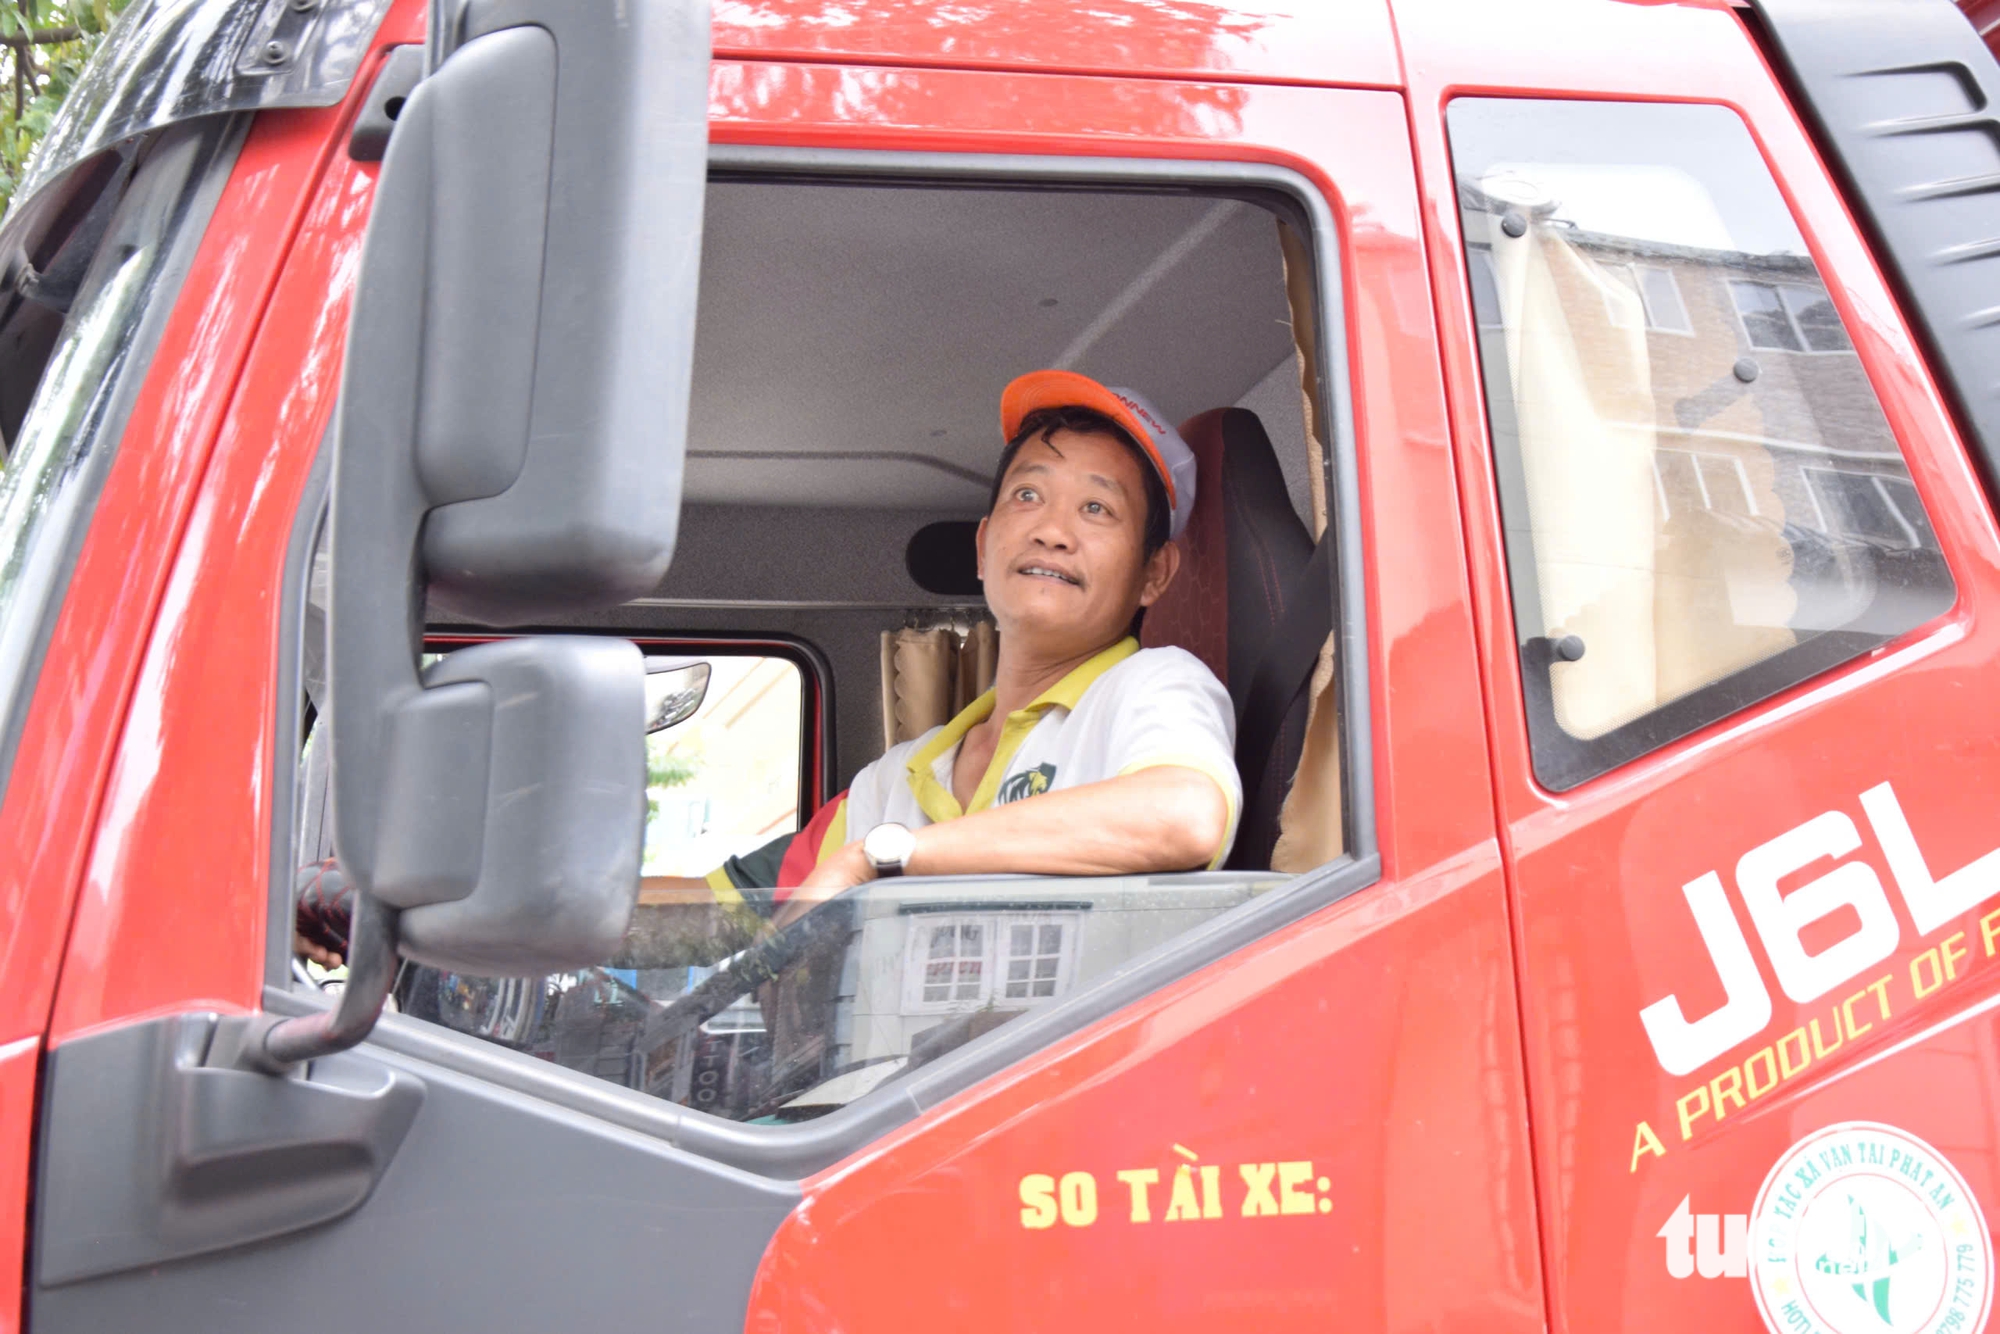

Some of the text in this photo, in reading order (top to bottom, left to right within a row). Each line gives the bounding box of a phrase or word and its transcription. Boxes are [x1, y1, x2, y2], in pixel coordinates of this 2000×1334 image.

[1639, 781, 2000, 1076] J6L
[1629, 1121, 1667, 1174] A
[1675, 974, 1894, 1142] PRODUCT
[1909, 930, 1967, 999] OF
[1018, 1143, 1333, 1229] SO TÀI XE:
[1952, 1276, 1975, 1308] 775
[1955, 1243, 1976, 1272] 779
